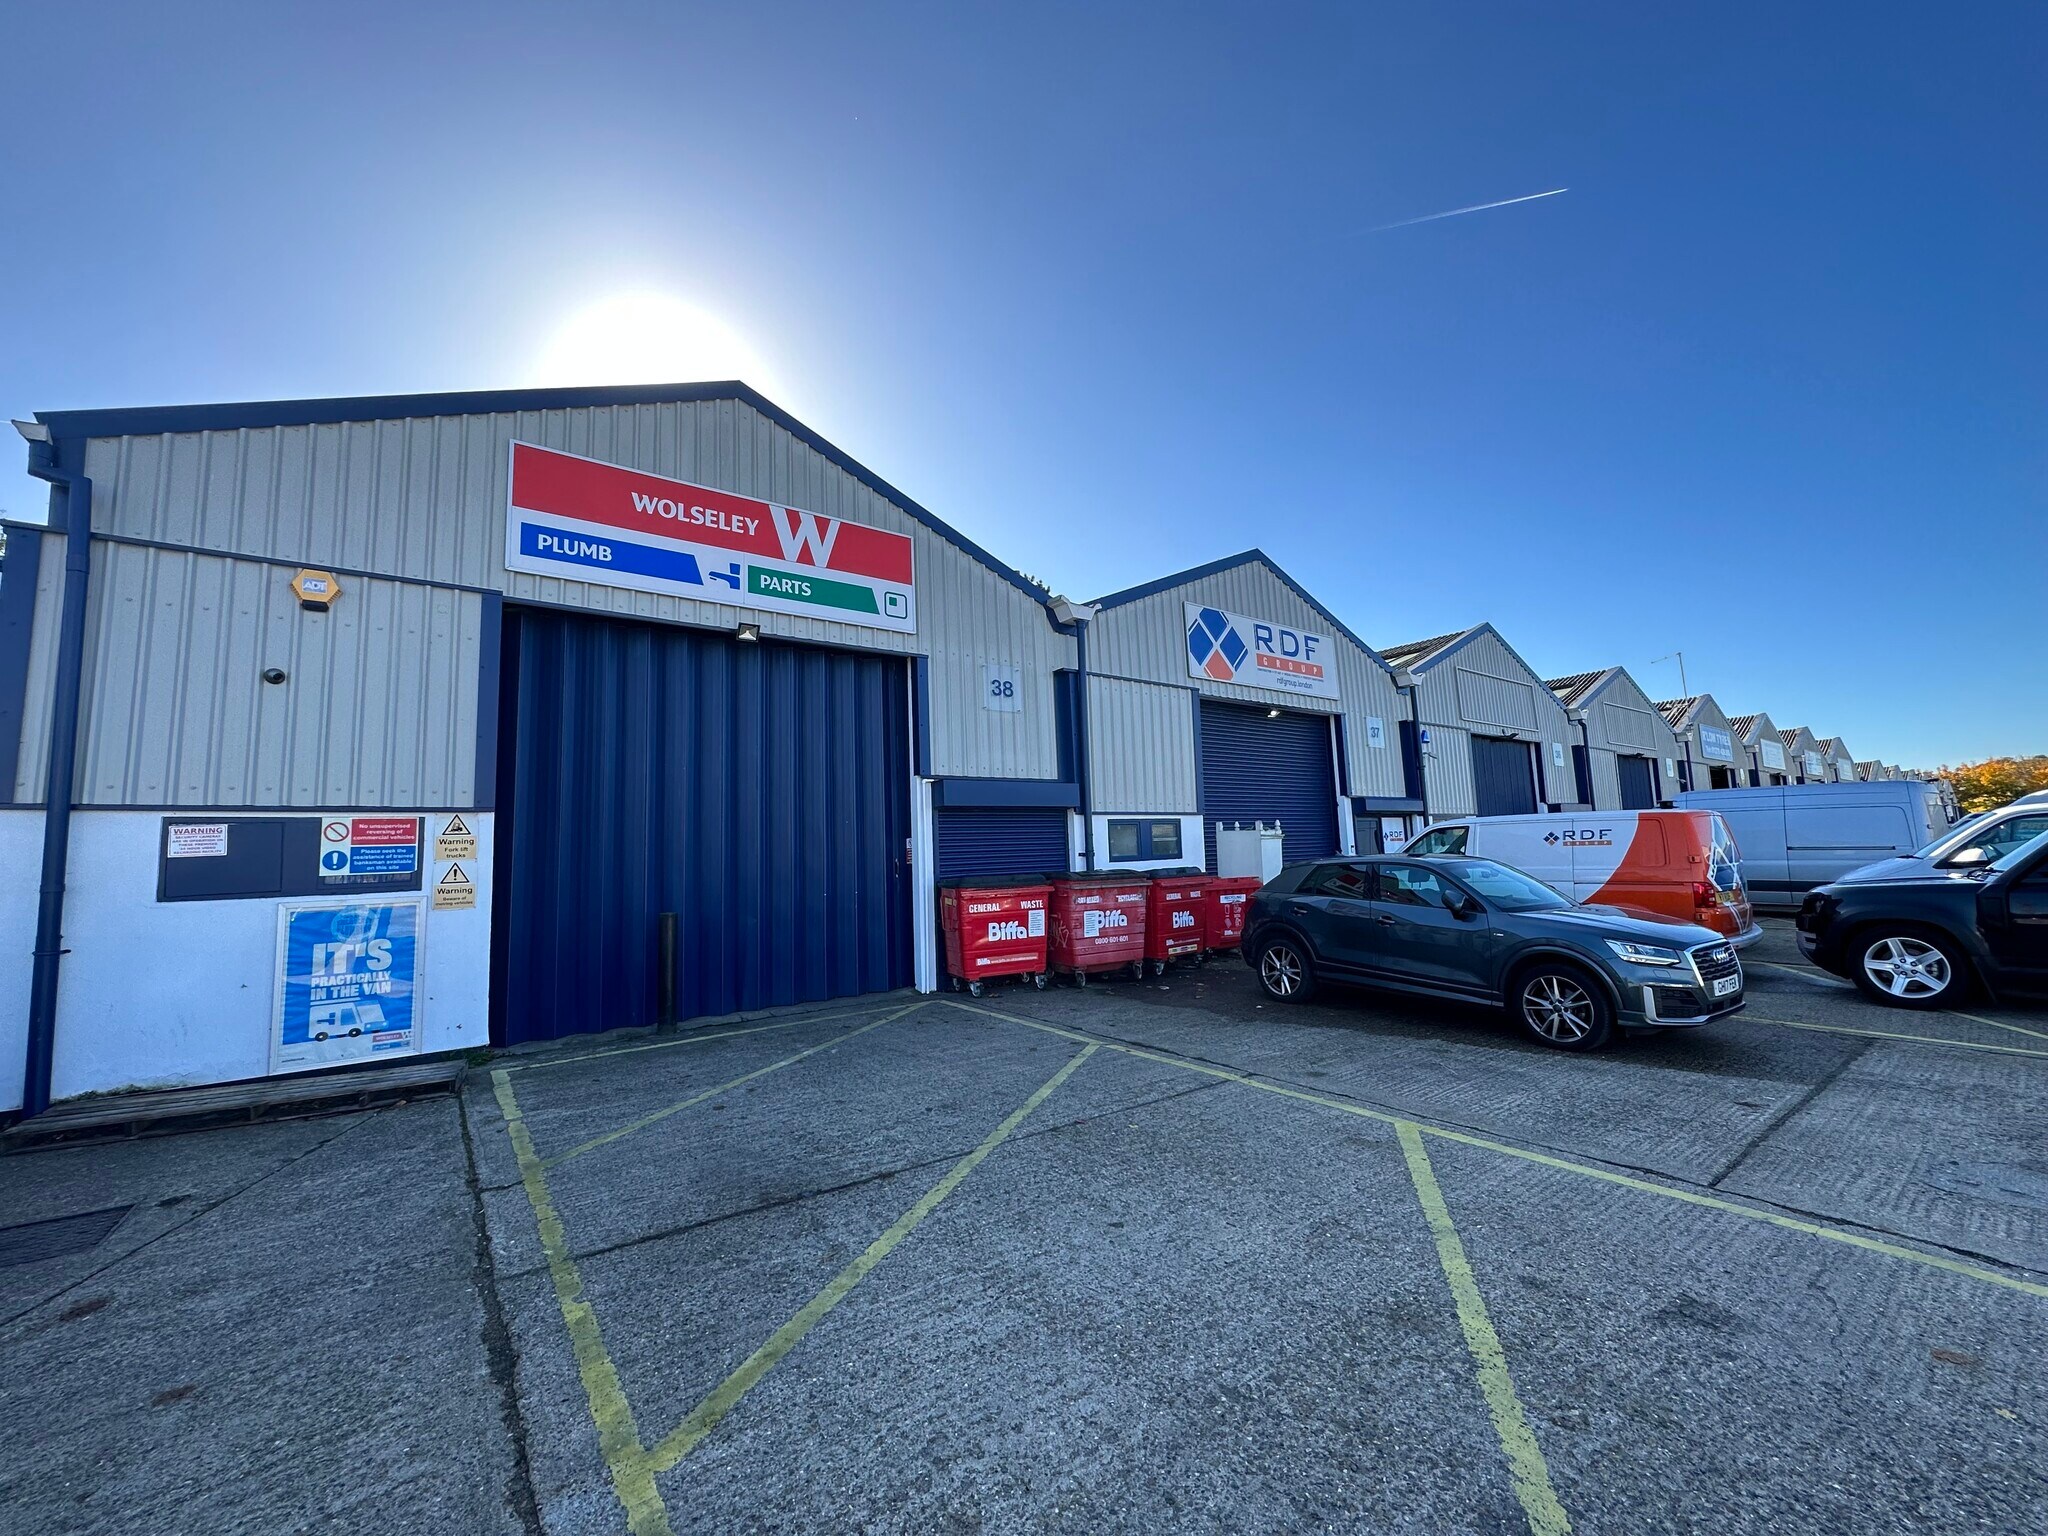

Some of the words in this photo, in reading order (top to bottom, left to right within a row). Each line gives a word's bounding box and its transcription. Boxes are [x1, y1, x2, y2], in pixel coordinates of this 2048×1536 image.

[631, 491, 759, 536] WOLSELEY
[769, 504, 840, 568] W
[538, 533, 613, 562] PLUMB
[303, 581, 327, 591] ADT
[760, 574, 812, 597] PARTS
[1253, 623, 1319, 660] RDF
[1263, 656, 1317, 674] GROUP
[991, 679, 1014, 698] 38
[1370, 726, 1380, 738] 37
[173, 827, 223, 835] WARNING
[369, 823, 411, 831] unsupervised
[1389, 830, 1403, 838] RDF
[1562, 829, 1612, 841] RDF
[438, 838, 475, 846] Warning
[437, 887, 473, 895] Warning
[968, 902, 1001, 914] GENERAL
[1020, 899, 1044, 909] WASTE
[1096, 909, 1128, 929] Biffa
[1173, 910, 1195, 929] Biffa
[988, 920, 1028, 942] Biffa
[312, 938, 393, 976] IT'S
[311, 970, 392, 988] PRACTICALLY
[310, 987, 327, 1000] IN
[330, 984, 360, 999] THE
[362, 981, 392, 996] VAN
